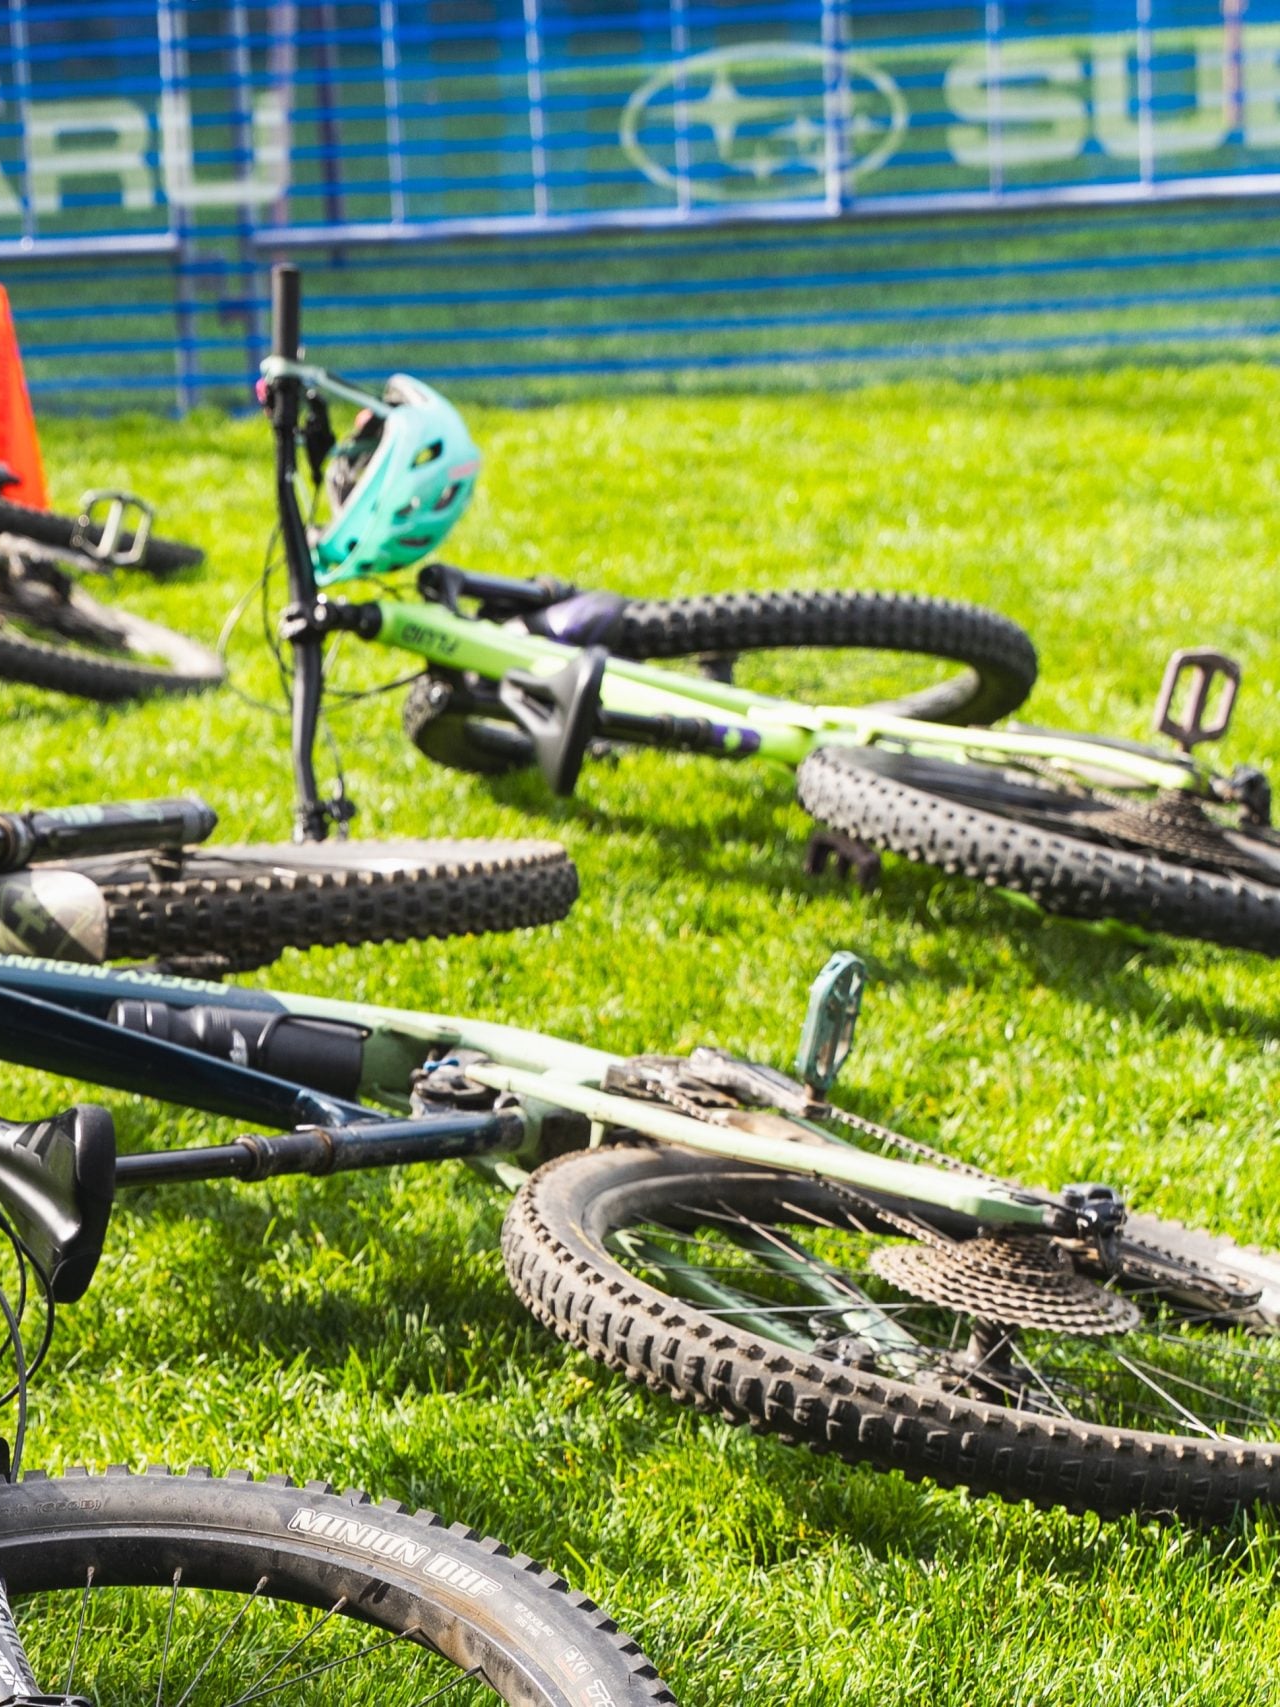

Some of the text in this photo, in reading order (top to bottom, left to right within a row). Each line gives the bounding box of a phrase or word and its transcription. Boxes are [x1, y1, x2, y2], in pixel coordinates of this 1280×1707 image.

[115, 970, 230, 996] ROCKY
[286, 1507, 503, 1598] MINION DHF
